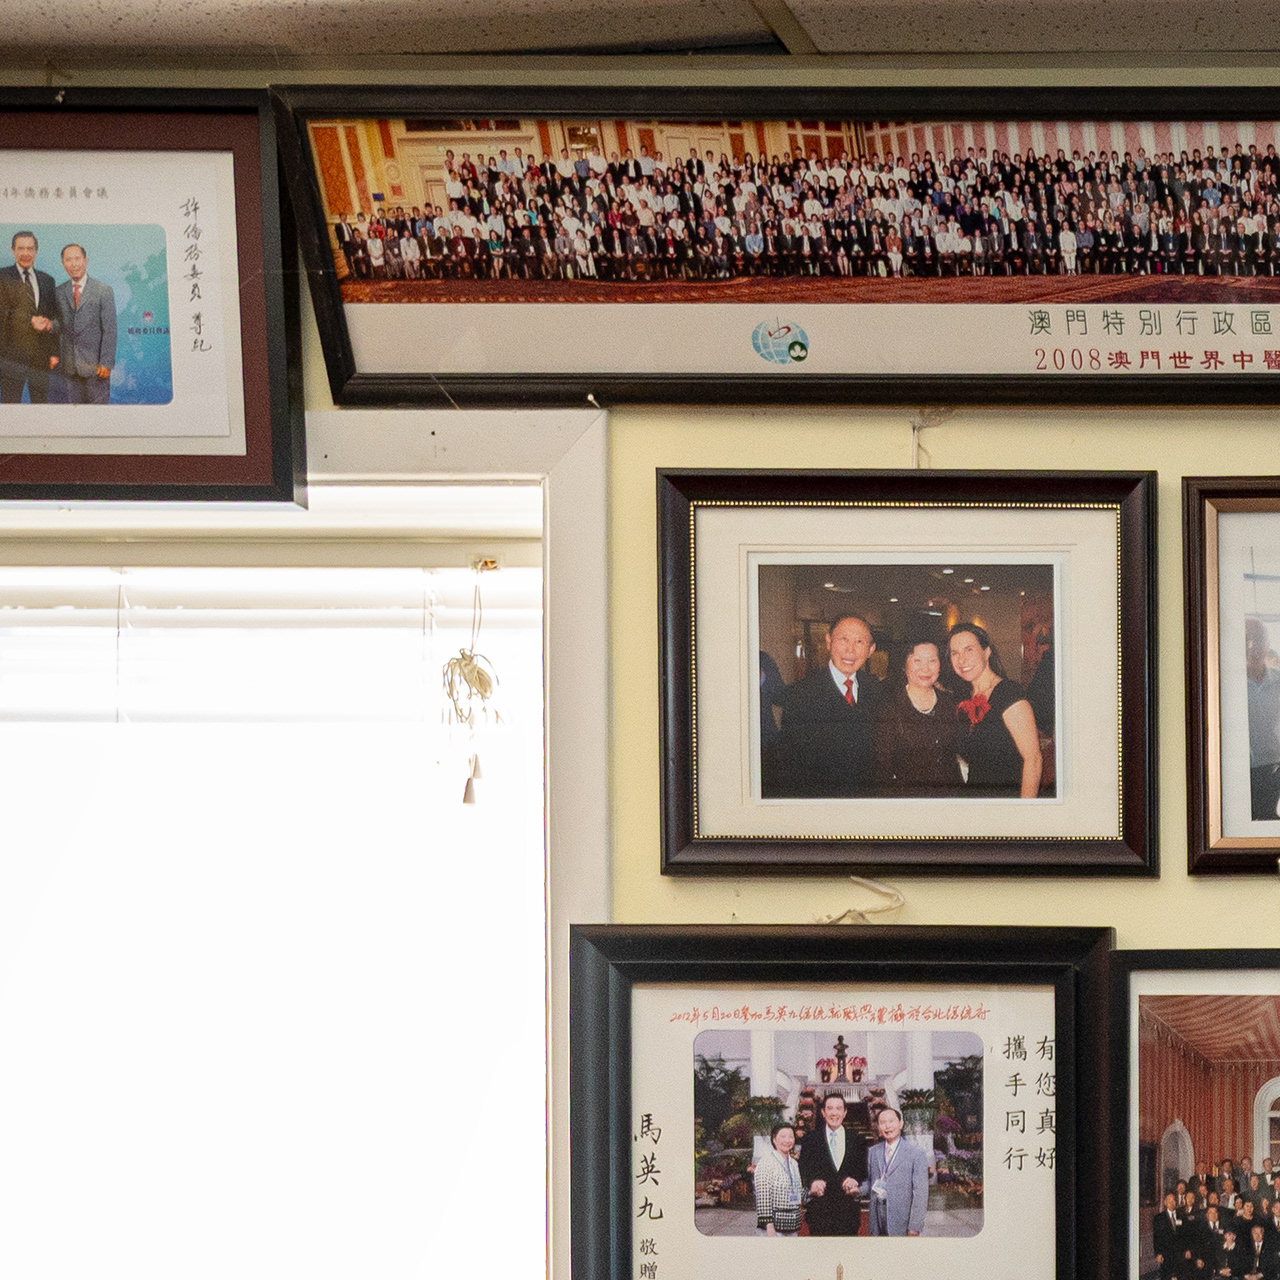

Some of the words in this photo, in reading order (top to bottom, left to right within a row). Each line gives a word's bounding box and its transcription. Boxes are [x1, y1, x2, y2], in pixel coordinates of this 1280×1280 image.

[1002, 1034, 1029, 1172] 攜手同行
[1034, 1034, 1056, 1171] 有您真好
[633, 1113, 664, 1220] 馬英九
[639, 1238, 659, 1280] 敬贈
